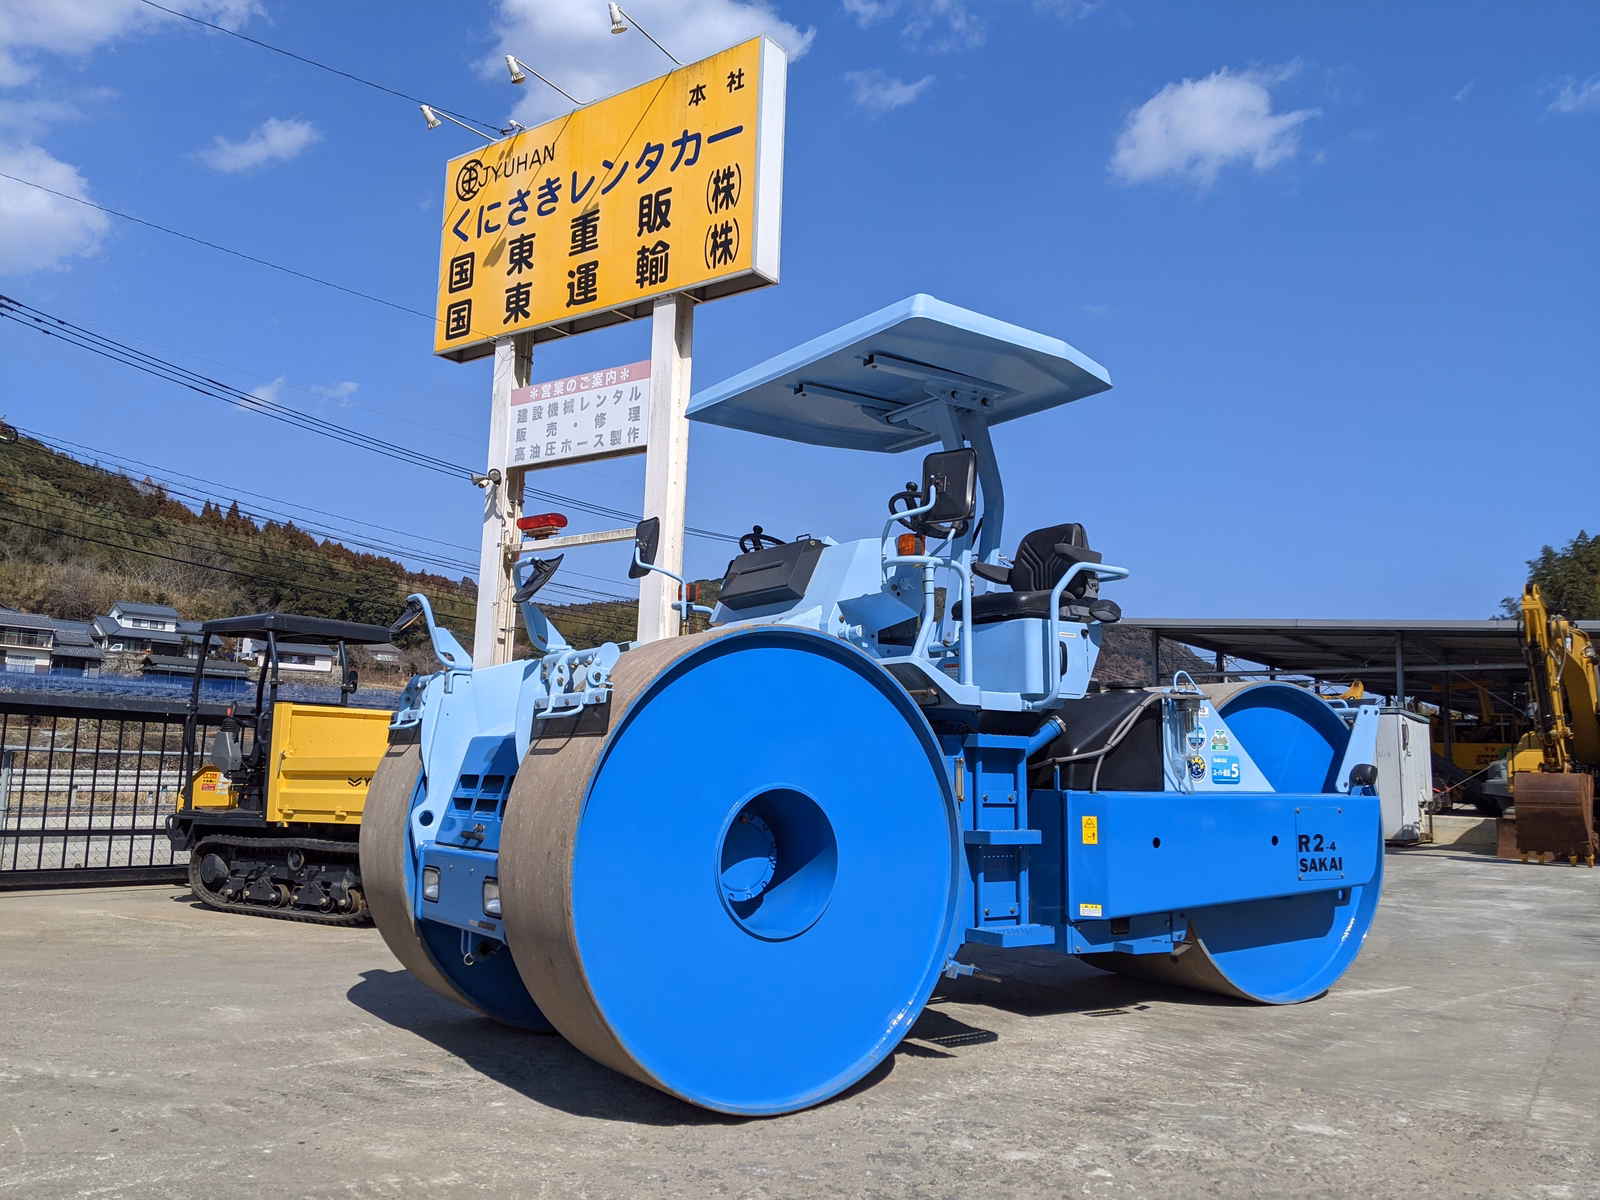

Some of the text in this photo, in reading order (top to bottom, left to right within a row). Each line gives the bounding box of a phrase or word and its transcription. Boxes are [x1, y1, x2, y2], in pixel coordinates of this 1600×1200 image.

[688, 68, 745, 107] 本社
[452, 125, 744, 242] くにさきレンタカー
[478, 142, 556, 187] JYUHAN
[517, 386, 642, 424] 建設機械レンタル
[514, 427, 640, 462] 高油圧ホース製作
[1299, 857, 1343, 872] SAKAI
